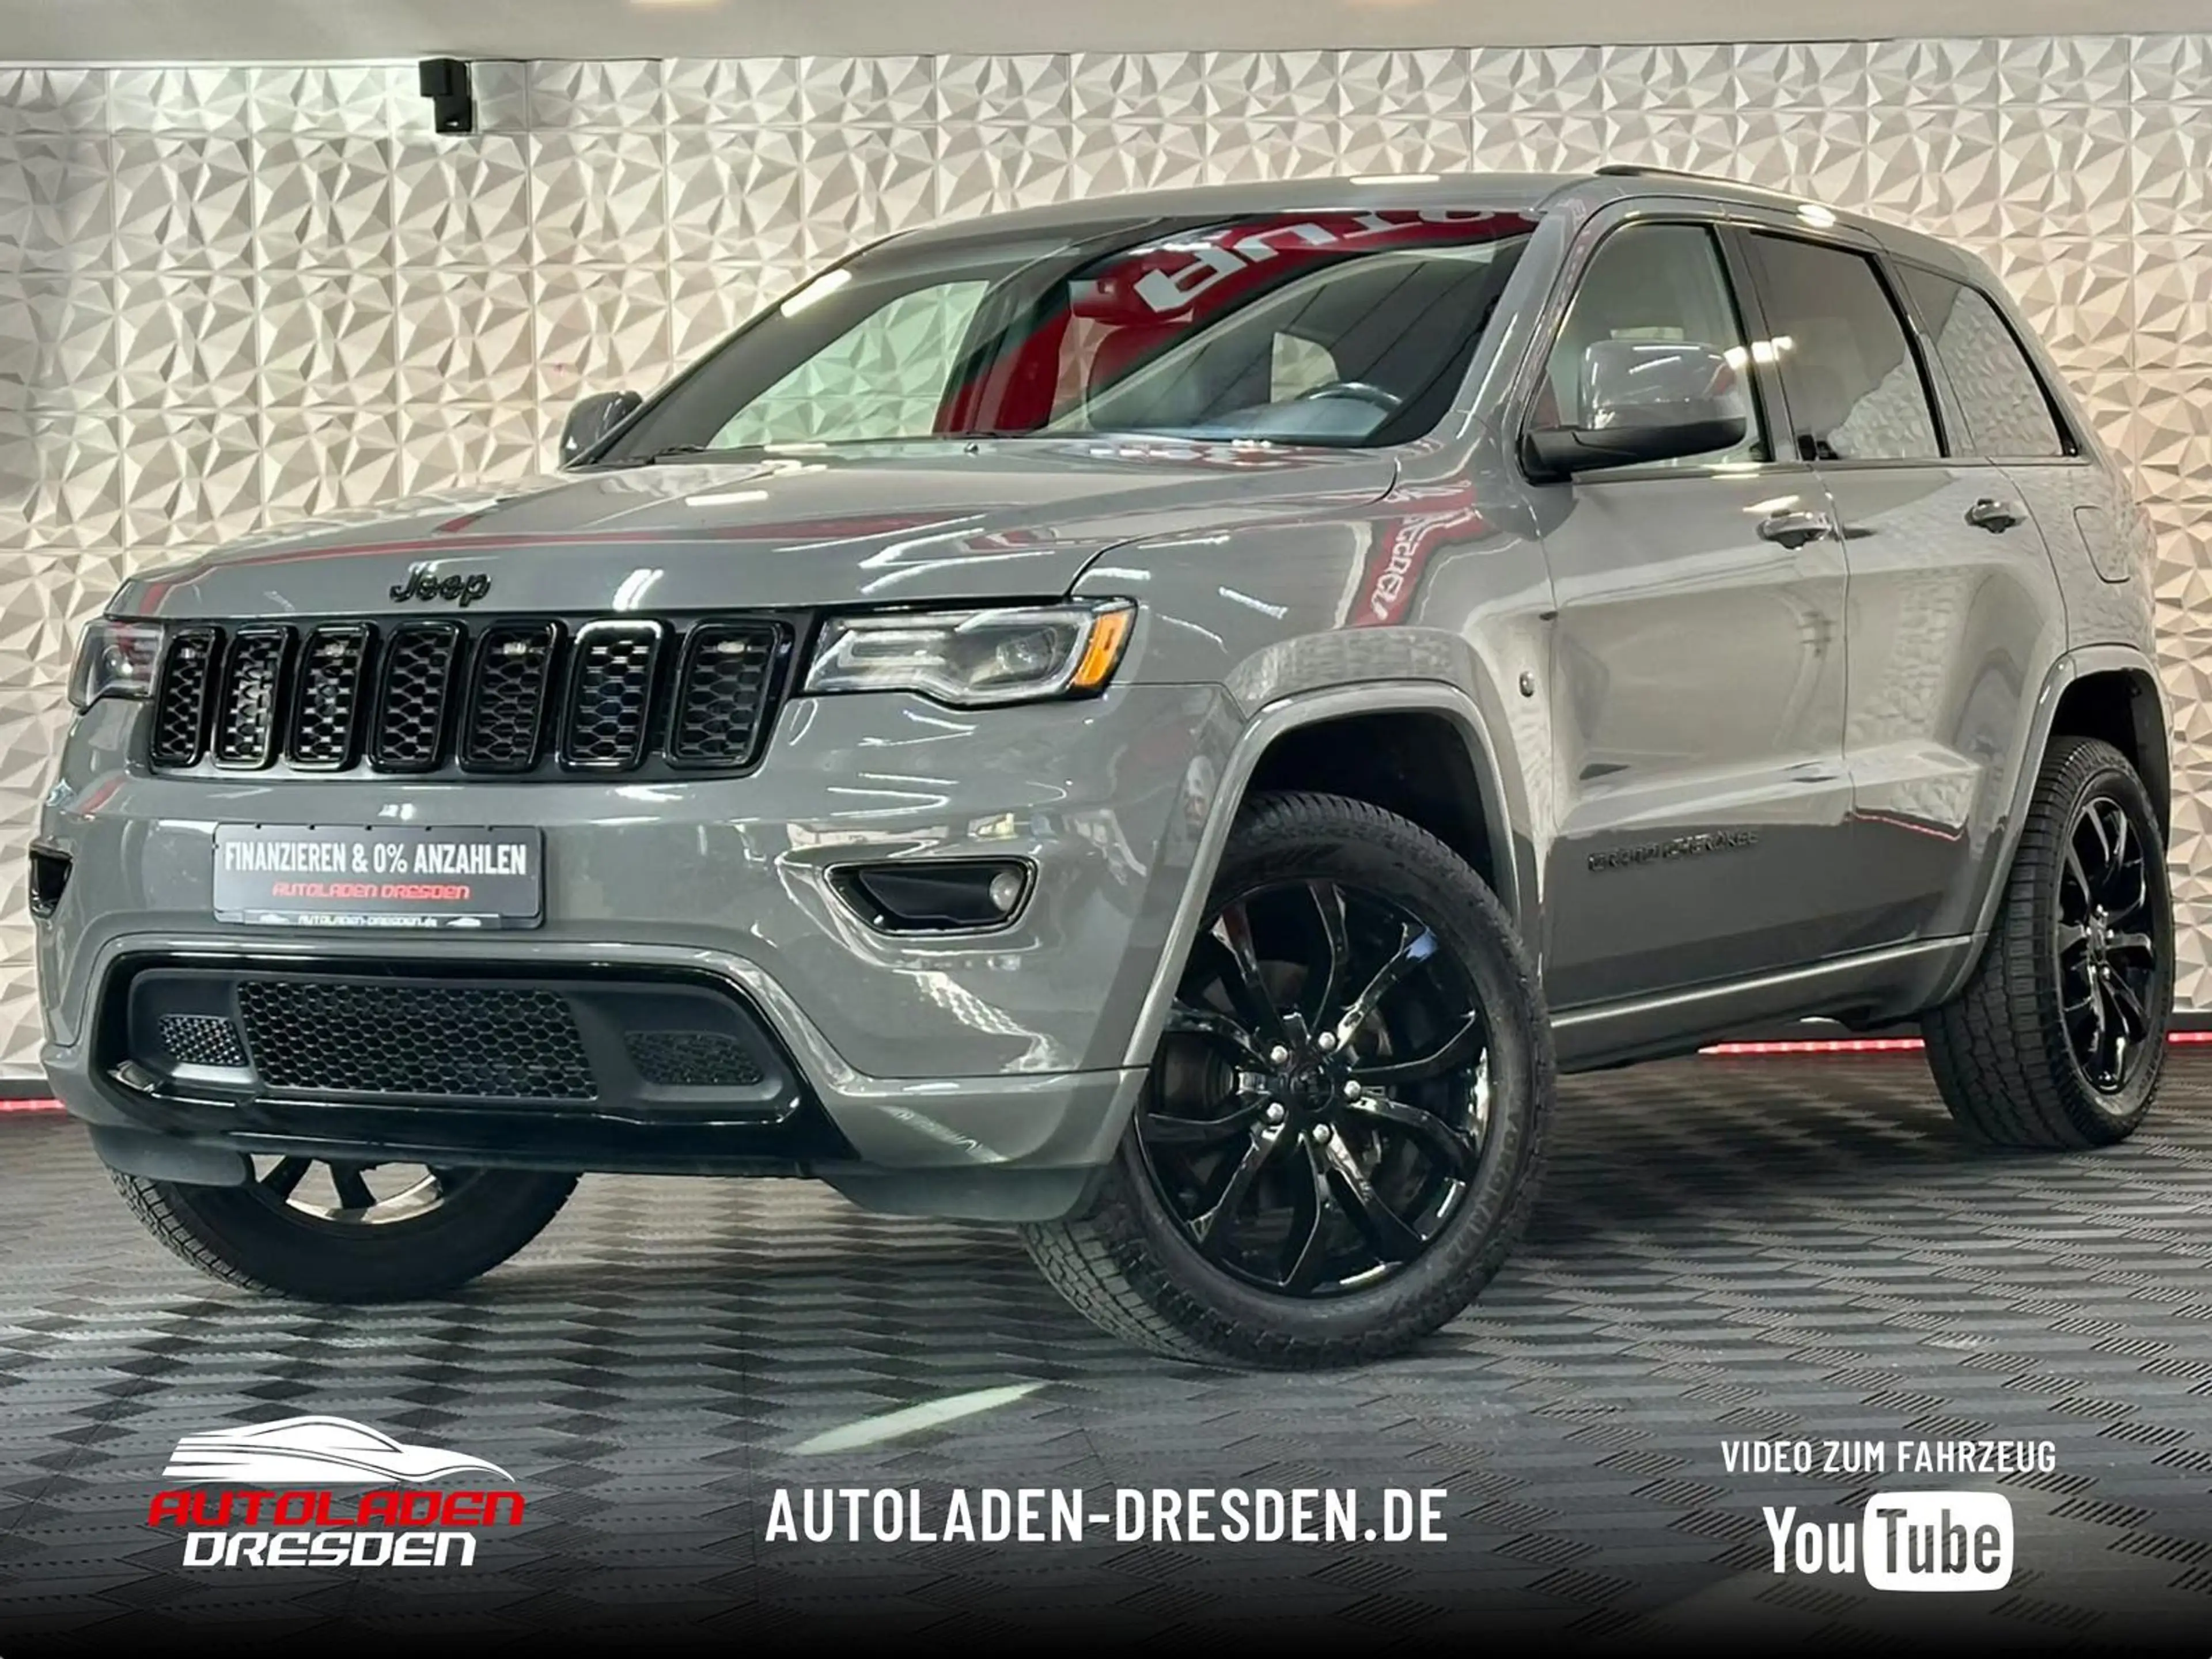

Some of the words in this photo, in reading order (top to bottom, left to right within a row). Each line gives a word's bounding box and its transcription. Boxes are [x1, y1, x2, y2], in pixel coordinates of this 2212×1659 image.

[389, 562, 491, 608] Jeep
[225, 841, 346, 872] FINANZIEREN
[352, 844, 369, 873] &
[374, 844, 408, 874] 0%
[414, 844, 527, 875] ANZAHLEN
[272, 882, 378, 899] AUTOLADEN
[381, 883, 470, 900] DRESDEN
